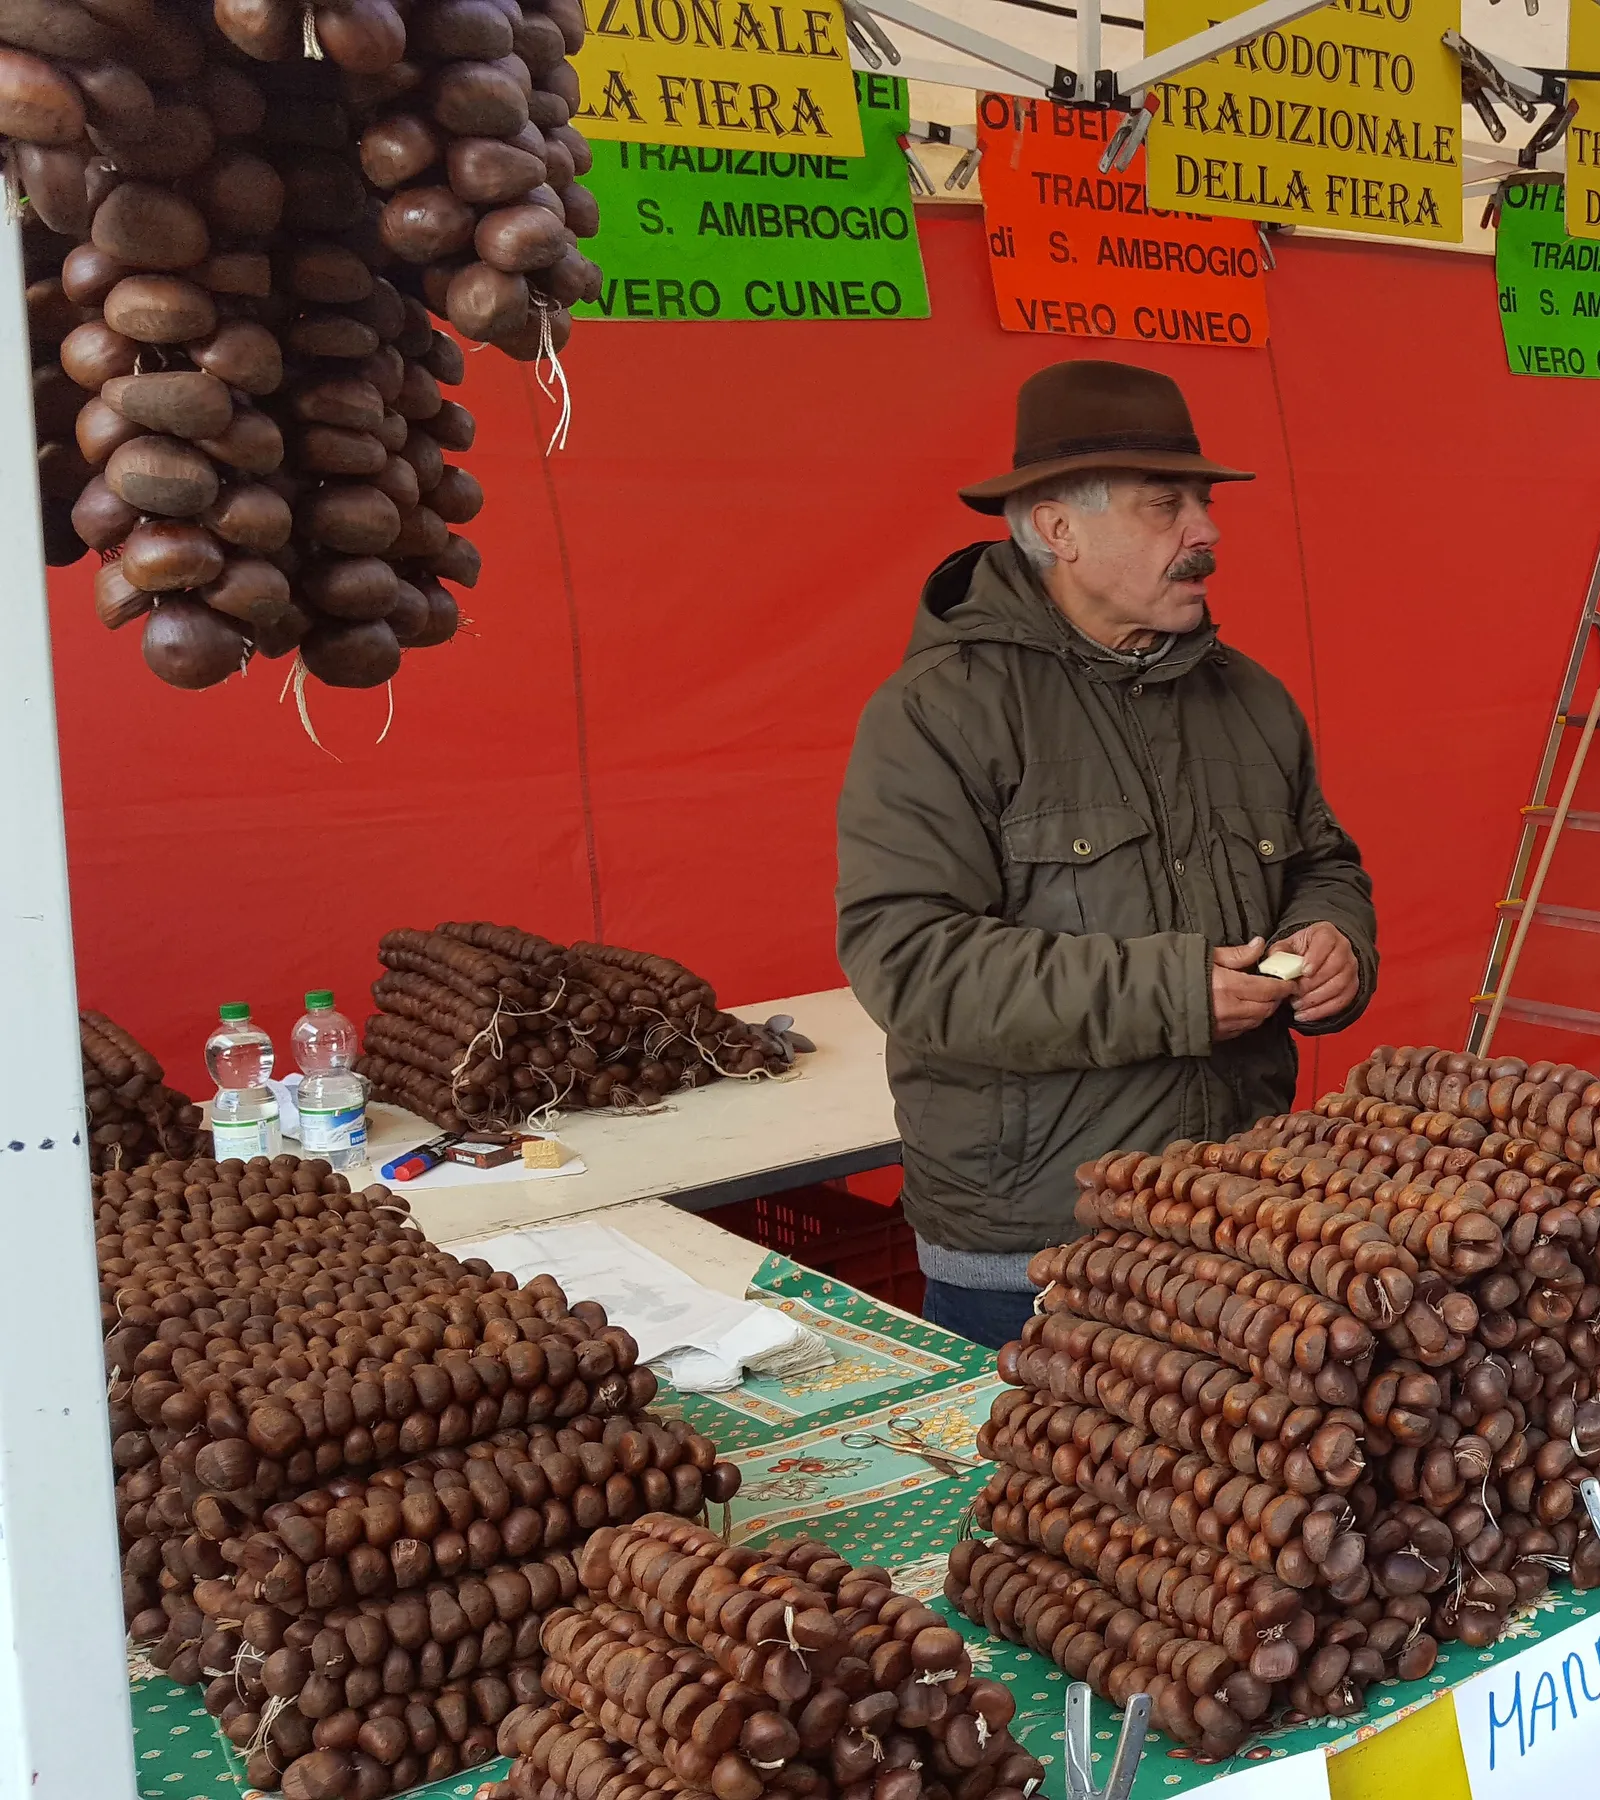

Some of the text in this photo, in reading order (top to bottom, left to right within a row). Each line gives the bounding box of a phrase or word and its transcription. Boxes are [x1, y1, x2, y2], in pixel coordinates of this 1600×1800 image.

[656, 73, 834, 139] FIERA
[980, 94, 1039, 133] OH
[1154, 81, 1458, 168] TRADIZIONALE
[1175, 154, 1444, 229] DELLA FIERA
[636, 198, 909, 241] S. AMBROGIO
[988, 225, 1260, 279] di S. AMBROGIO
[597, 278, 903, 318] VERO CUNEO
[1500, 286, 1517, 313] di
[1539, 289, 1560, 316] S.
[1015, 297, 1252, 345] VERO CUNEO
[1518, 345, 1586, 375] VERO
